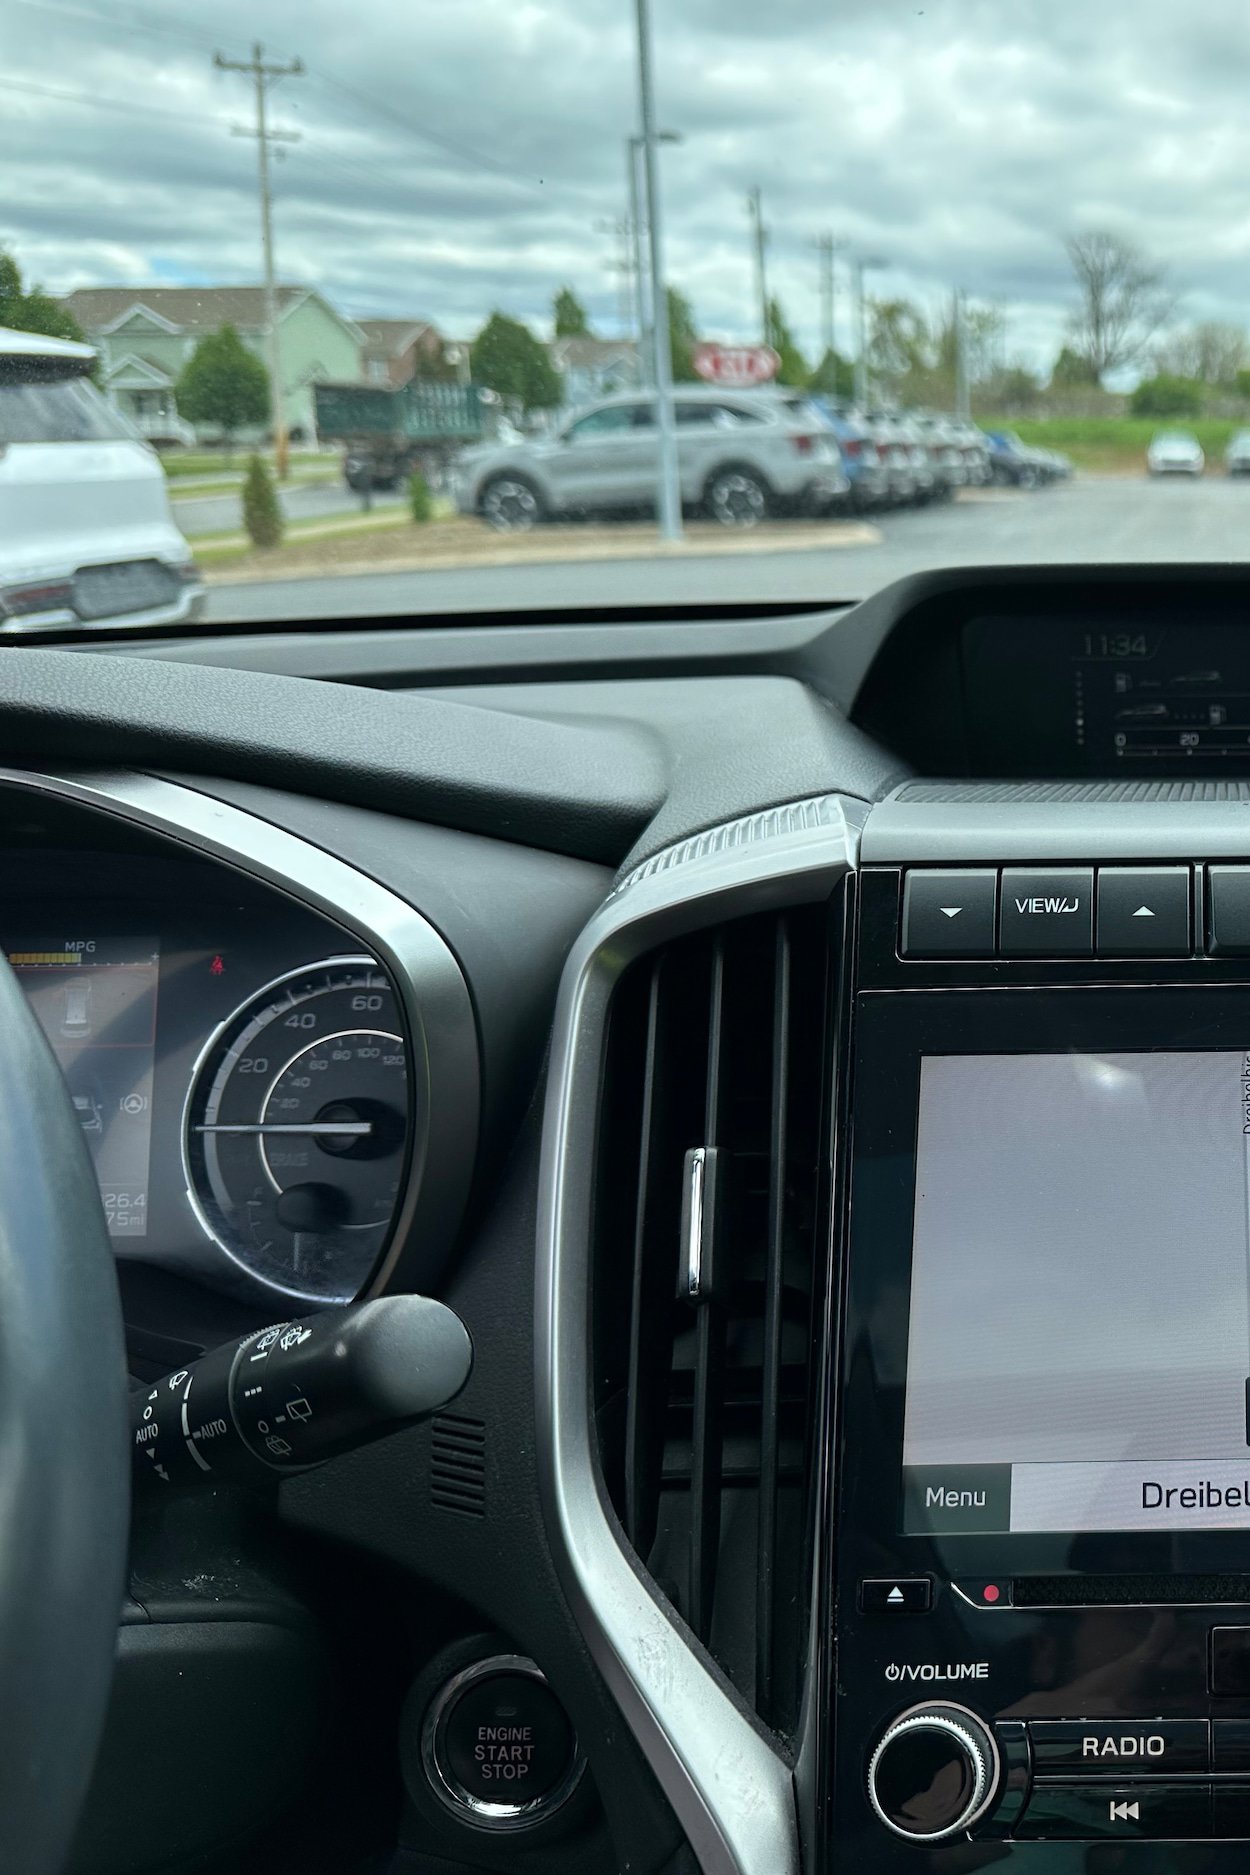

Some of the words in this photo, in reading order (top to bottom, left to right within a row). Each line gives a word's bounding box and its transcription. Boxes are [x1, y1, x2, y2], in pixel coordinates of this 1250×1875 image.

[1114, 732, 1126, 746] 0
[1179, 733, 1199, 746] 20
[65, 940, 96, 953] MPG
[351, 995, 383, 1011] 60
[284, 1013, 316, 1029] 40
[238, 1058, 269, 1074] 20
[136, 1423, 158, 1444] AUTO
[200, 1418, 227, 1439] AUTO
[925, 1486, 986, 1507] Menu
[478, 1727, 532, 1741] ENGINE
[474, 1745, 535, 1760] START
[1082, 1736, 1165, 1756] RADIO
[481, 1764, 529, 1779] STOP
